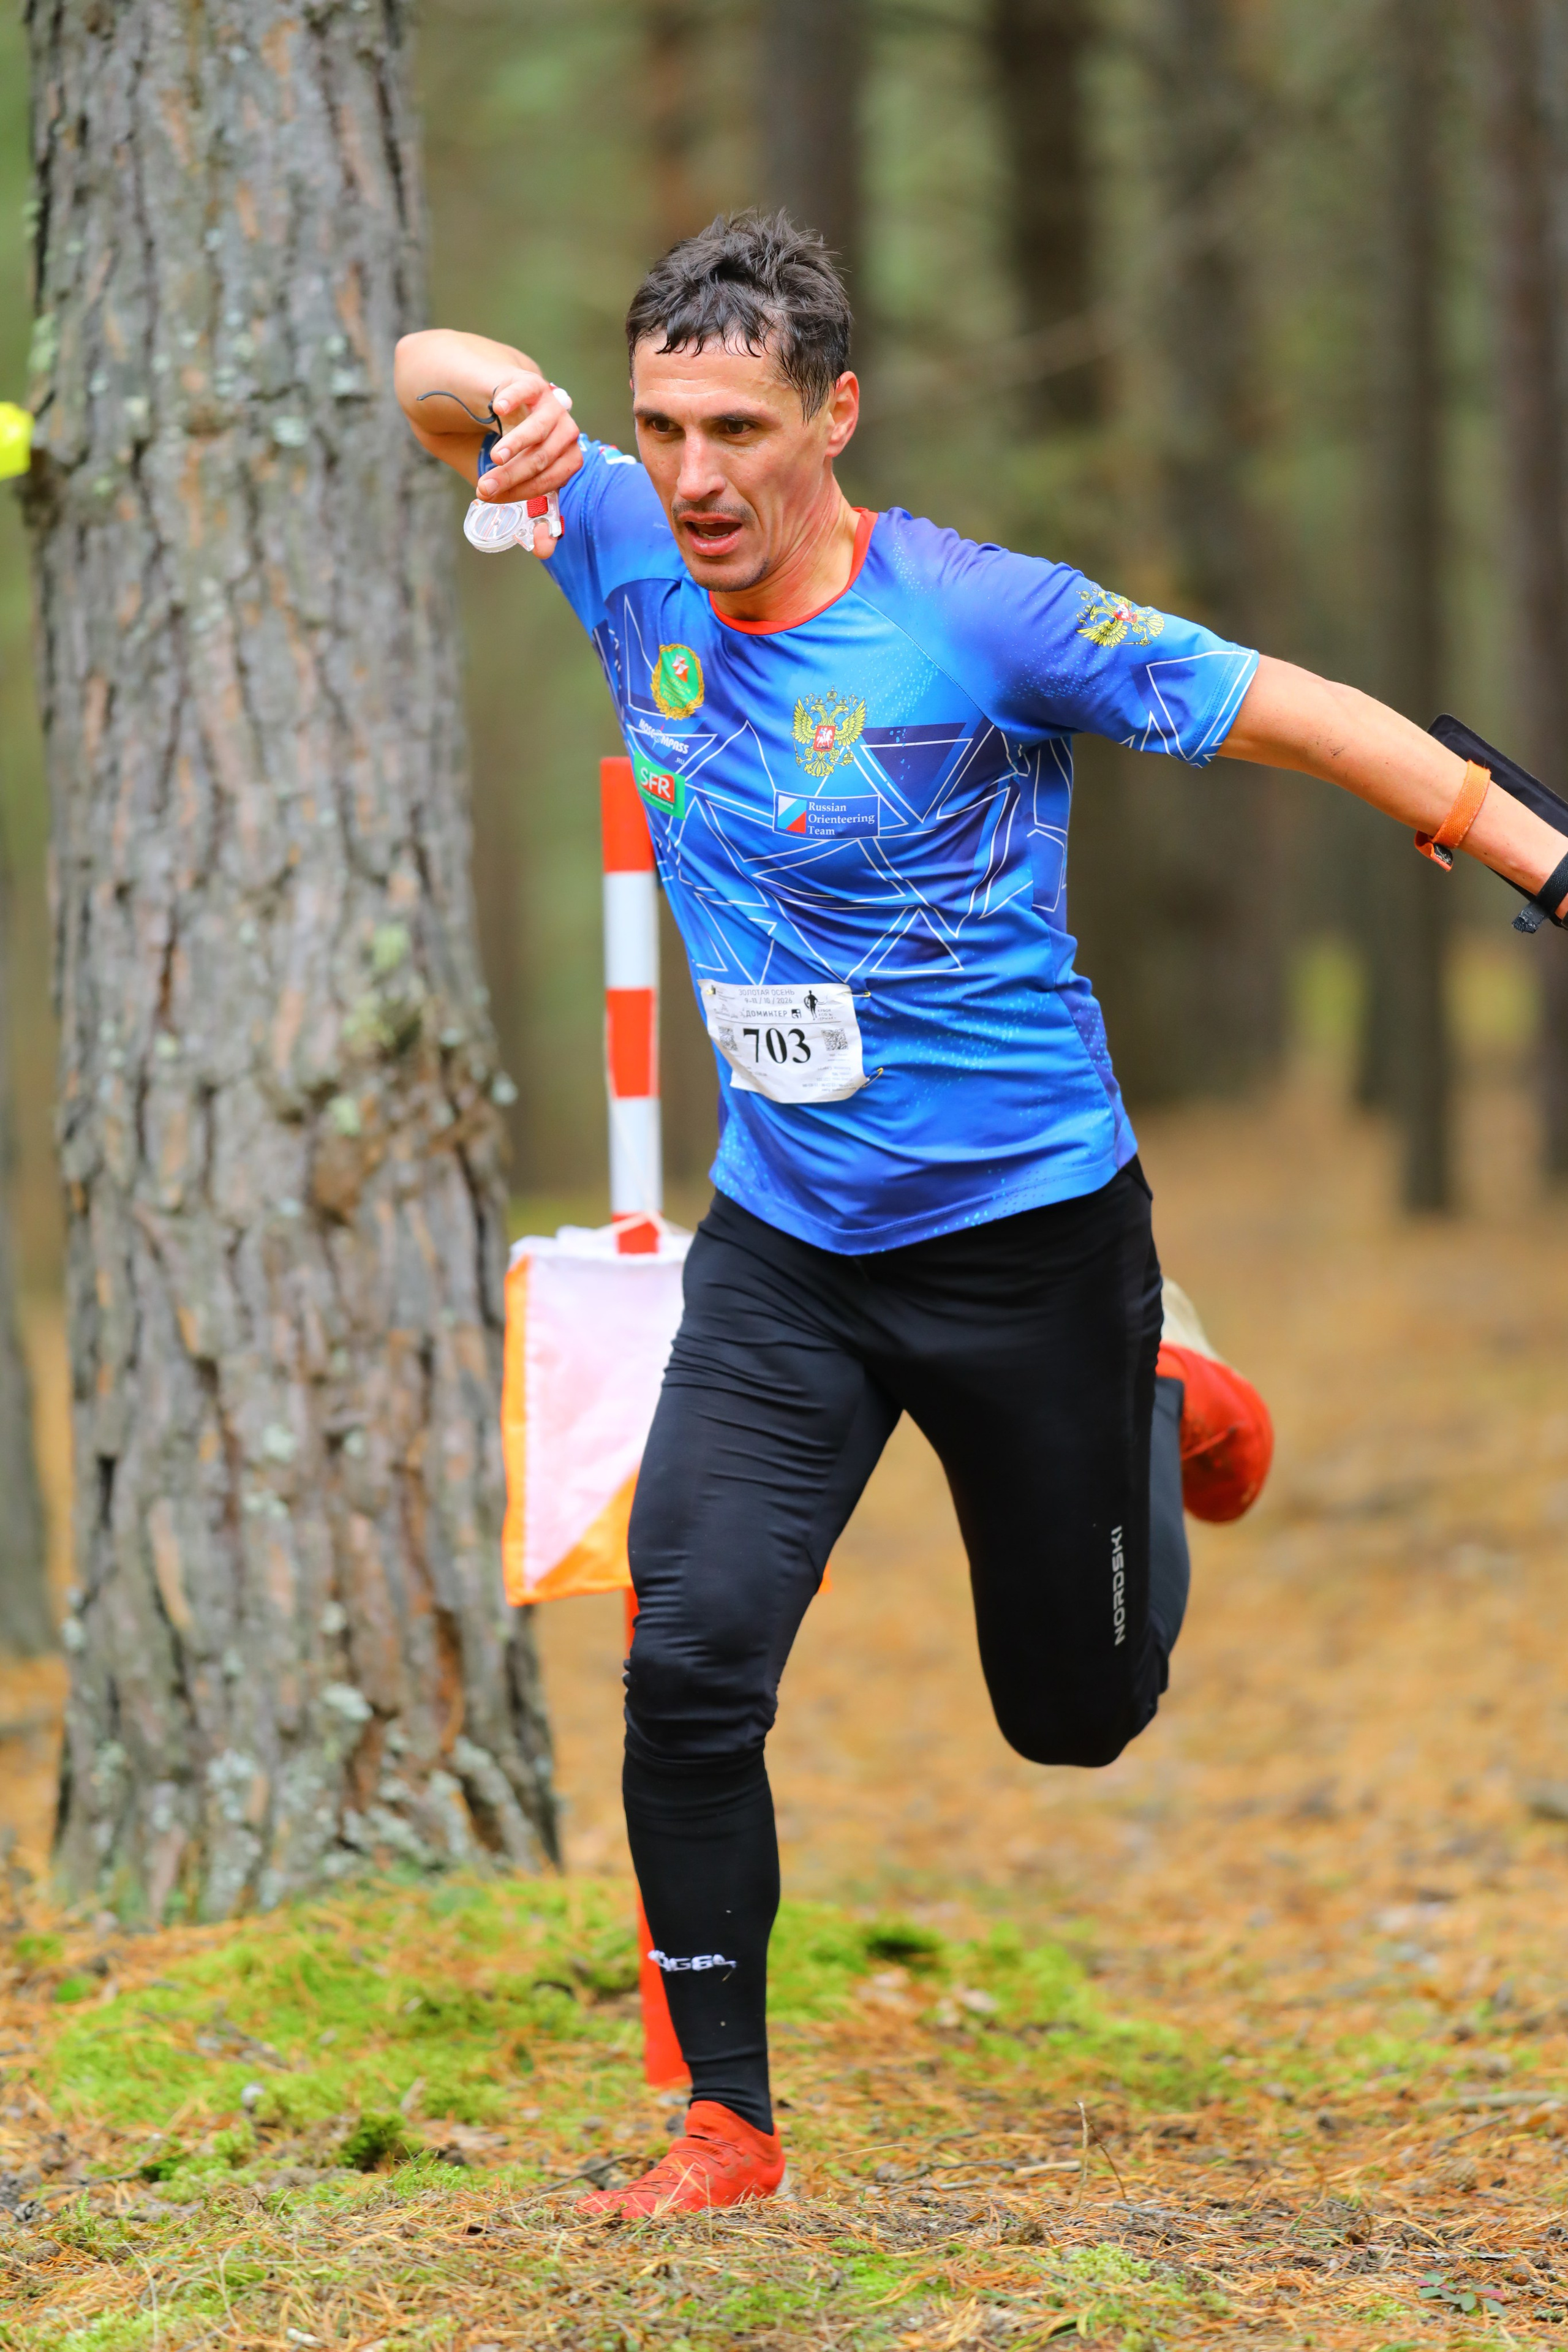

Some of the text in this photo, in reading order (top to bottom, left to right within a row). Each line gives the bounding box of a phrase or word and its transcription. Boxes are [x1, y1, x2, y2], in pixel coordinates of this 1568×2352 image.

[640, 767, 671, 799] SFR
[809, 802, 846, 812] Russian
[808, 814, 875, 824] Orienteering
[807, 826, 835, 835] Team
[743, 1028, 812, 1064] 703
[1111, 1525, 1125, 1646] NORDSKI
